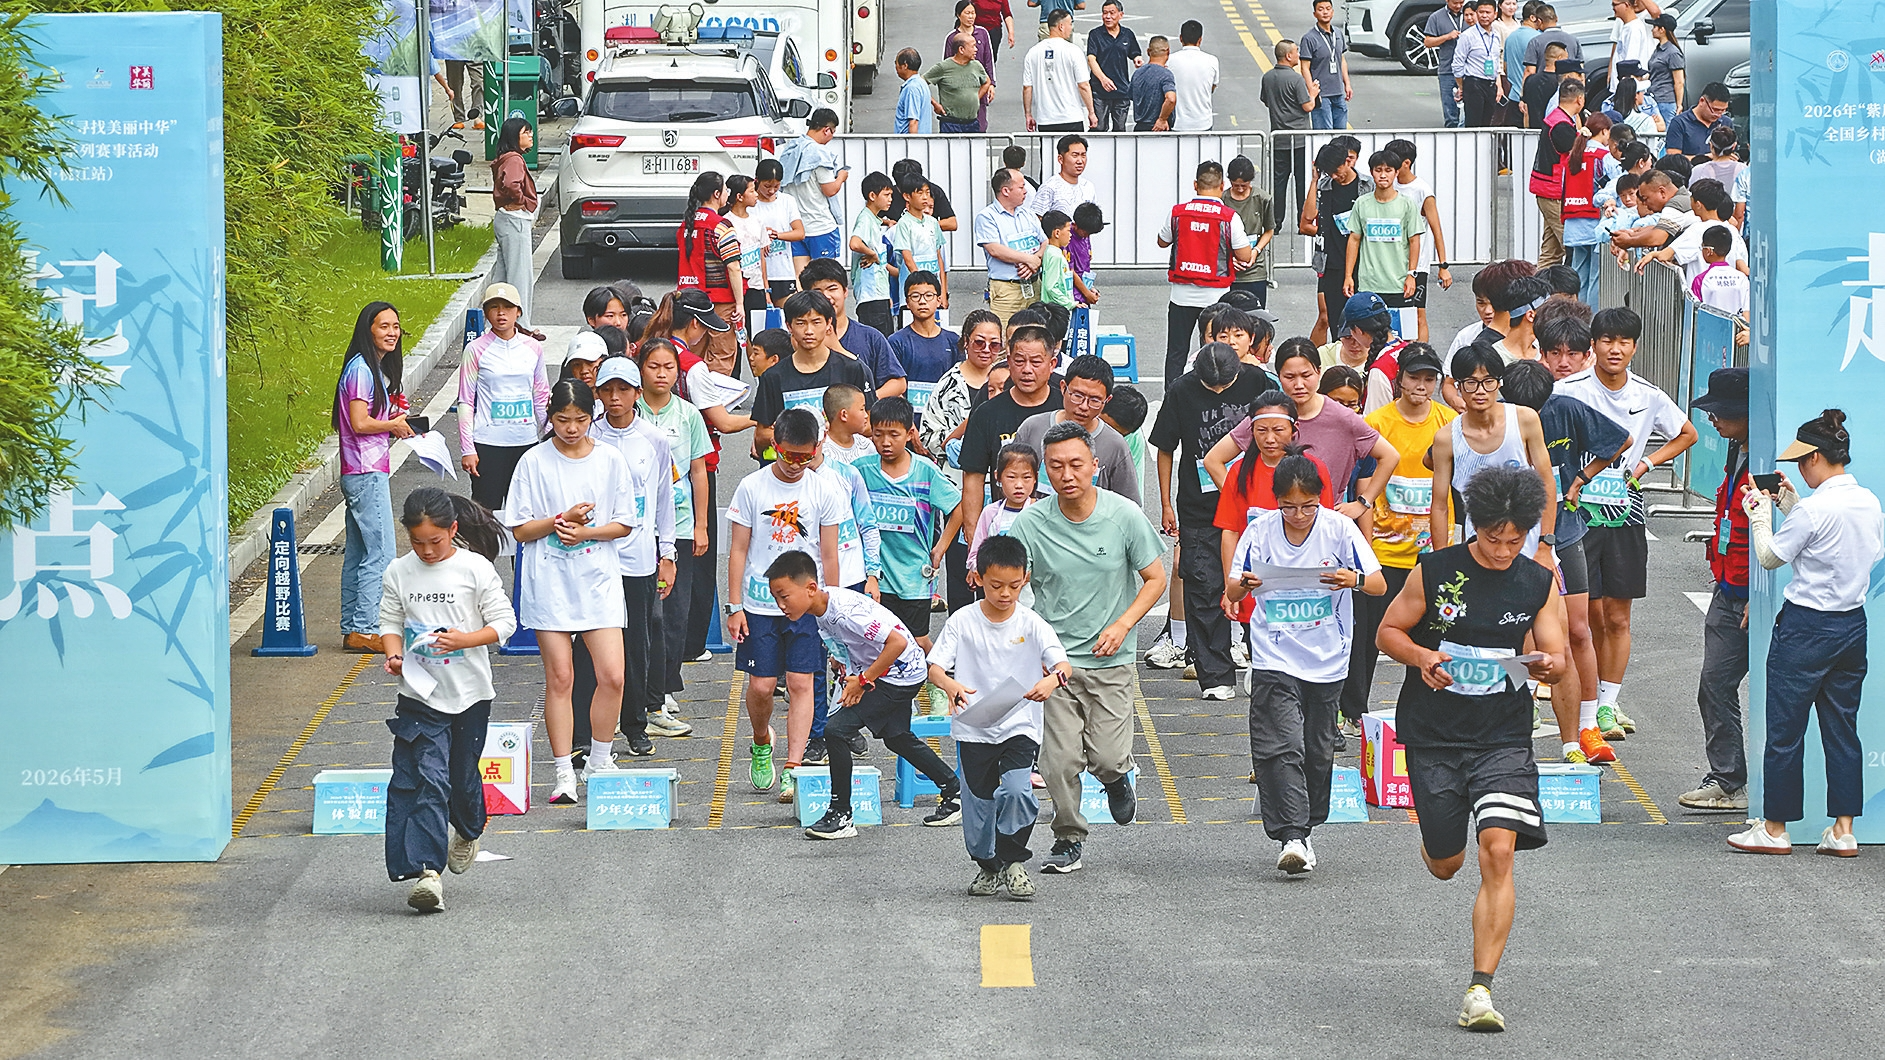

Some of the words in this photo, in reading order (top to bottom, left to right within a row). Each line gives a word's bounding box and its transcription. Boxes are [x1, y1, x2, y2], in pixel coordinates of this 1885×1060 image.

[1804, 103, 1885, 118] 2026年“紫
[1823, 126, 1885, 142] 全国乡村
[1370, 225, 1398, 235] 6060
[496, 403, 530, 418] 3011
[873, 505, 909, 523] 030
[274, 540, 291, 632] 定向越野比赛
[1275, 603, 1325, 619] 5006
[1447, 660, 1499, 683] 6051
[21, 766, 122, 787] 2026年5月
[1386, 782, 1410, 794] 定向
[1386, 795, 1410, 806] 运动
[331, 808, 378, 820] 体验组
[595, 803, 661, 816] 少年女子组
